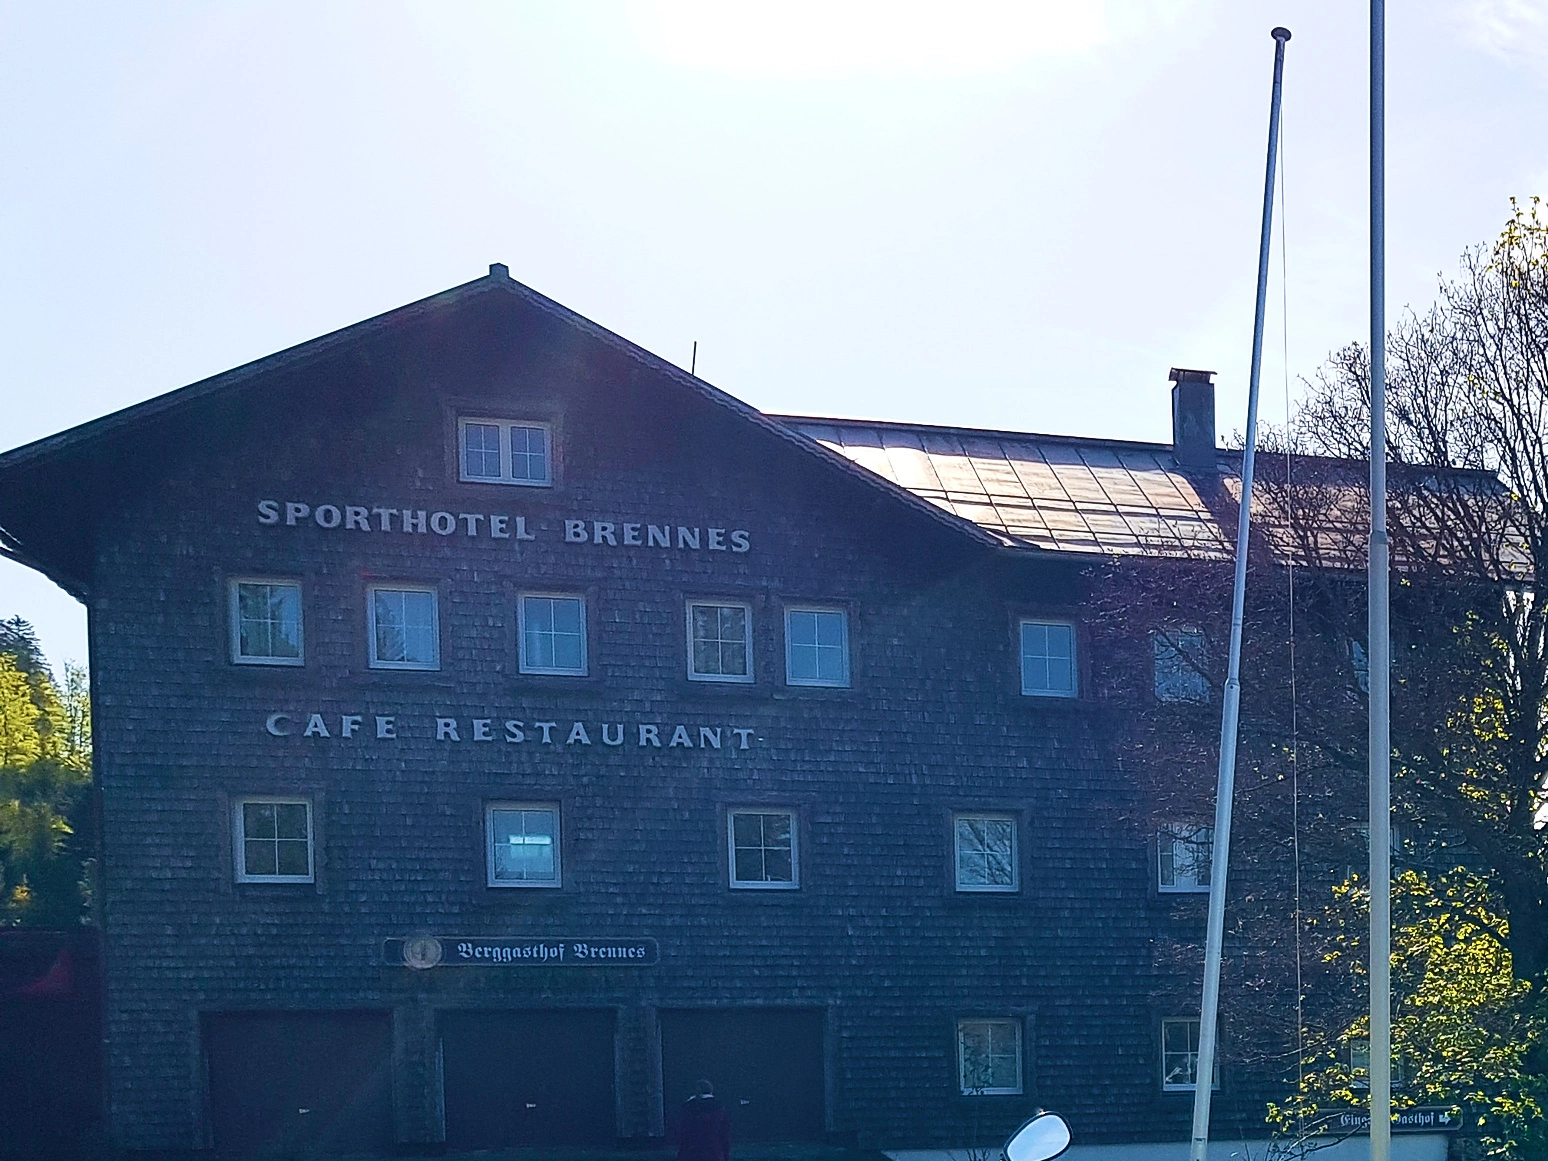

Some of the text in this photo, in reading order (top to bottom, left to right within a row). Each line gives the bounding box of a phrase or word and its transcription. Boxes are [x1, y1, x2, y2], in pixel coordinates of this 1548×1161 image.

[257, 500, 751, 552] SPORTHOTEL BRENNES
[265, 713, 756, 750] CAFE RESTAURANT
[457, 942, 646, 962] Berggasthof Brennes
